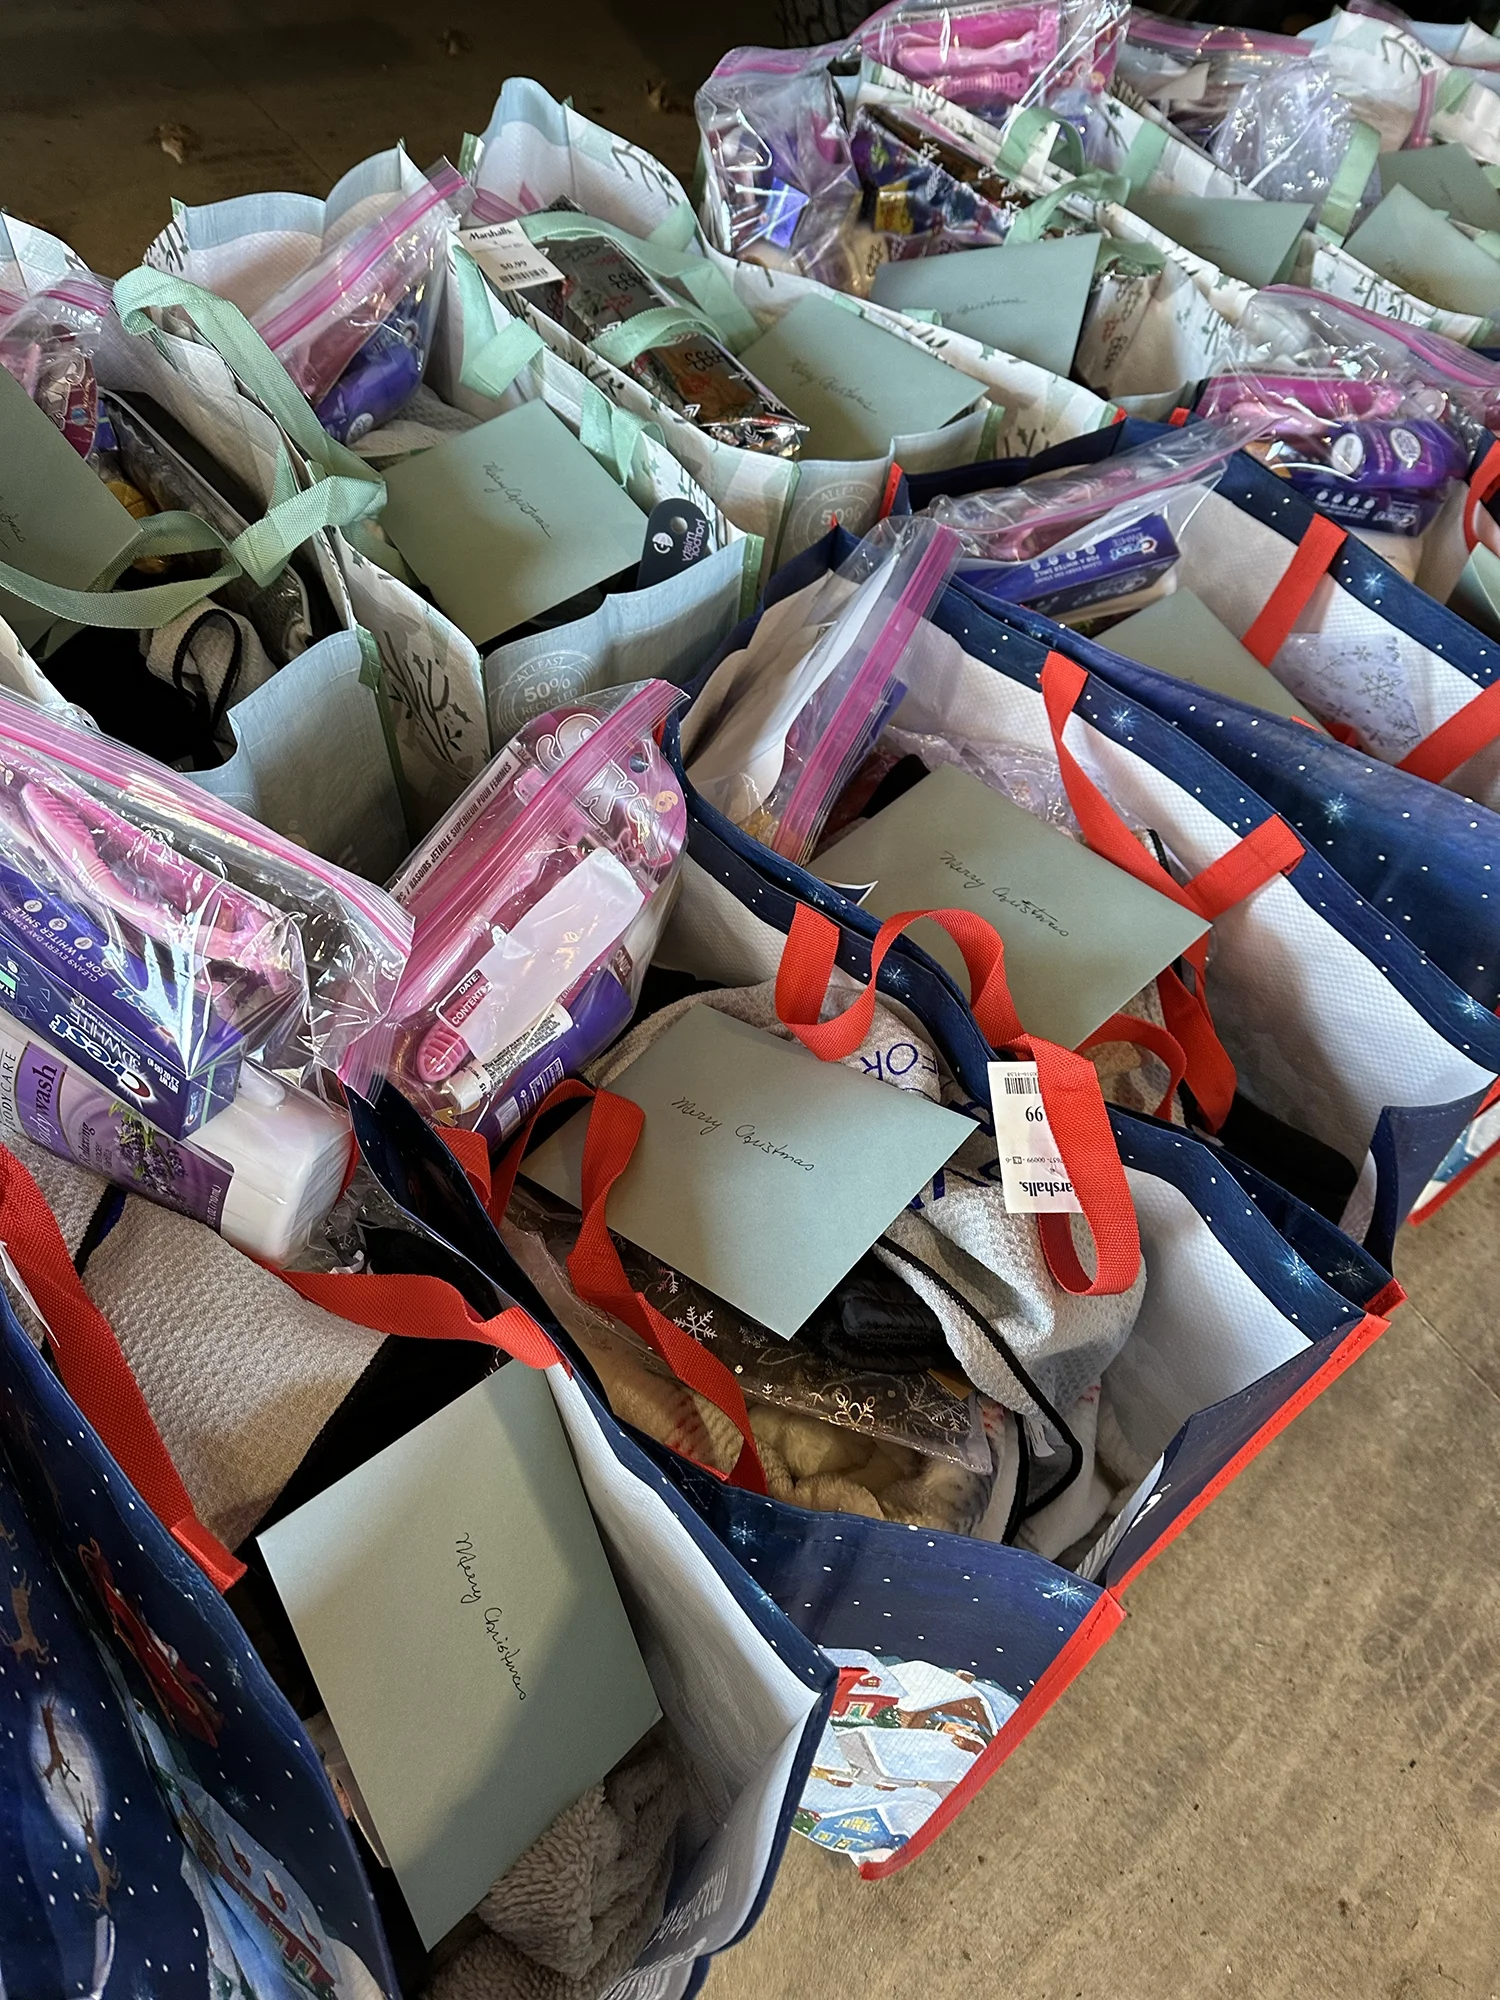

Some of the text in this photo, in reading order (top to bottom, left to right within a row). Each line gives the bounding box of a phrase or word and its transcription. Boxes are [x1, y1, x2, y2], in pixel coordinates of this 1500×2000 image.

[516, 656, 566, 682] AT LEAST
[521, 687, 578, 716] RECYCLED
[524, 674, 571, 703] 50%
[430, 833, 453, 863] JETABLE
[476, 787, 493, 807] POUR
[490, 761, 512, 791] FEMMES
[940, 850, 1069, 937] Merry Christmas
[12, 906, 41, 928] SMILE
[1, 909, 98, 983] CLEANS EVERY DAY STAINS
[40, 927, 77, 956] WHITER
[85, 960, 107, 978] FOR
[613, 947, 632, 977] ONUS
[458, 972, 481, 995] DATE:
[49, 1013, 153, 1099] Crest
[671, 1096, 815, 1171] Merry Christmas
[1018, 1181, 1076, 1198] arshalls.
[455, 1532, 526, 1701] Merry Christmas
